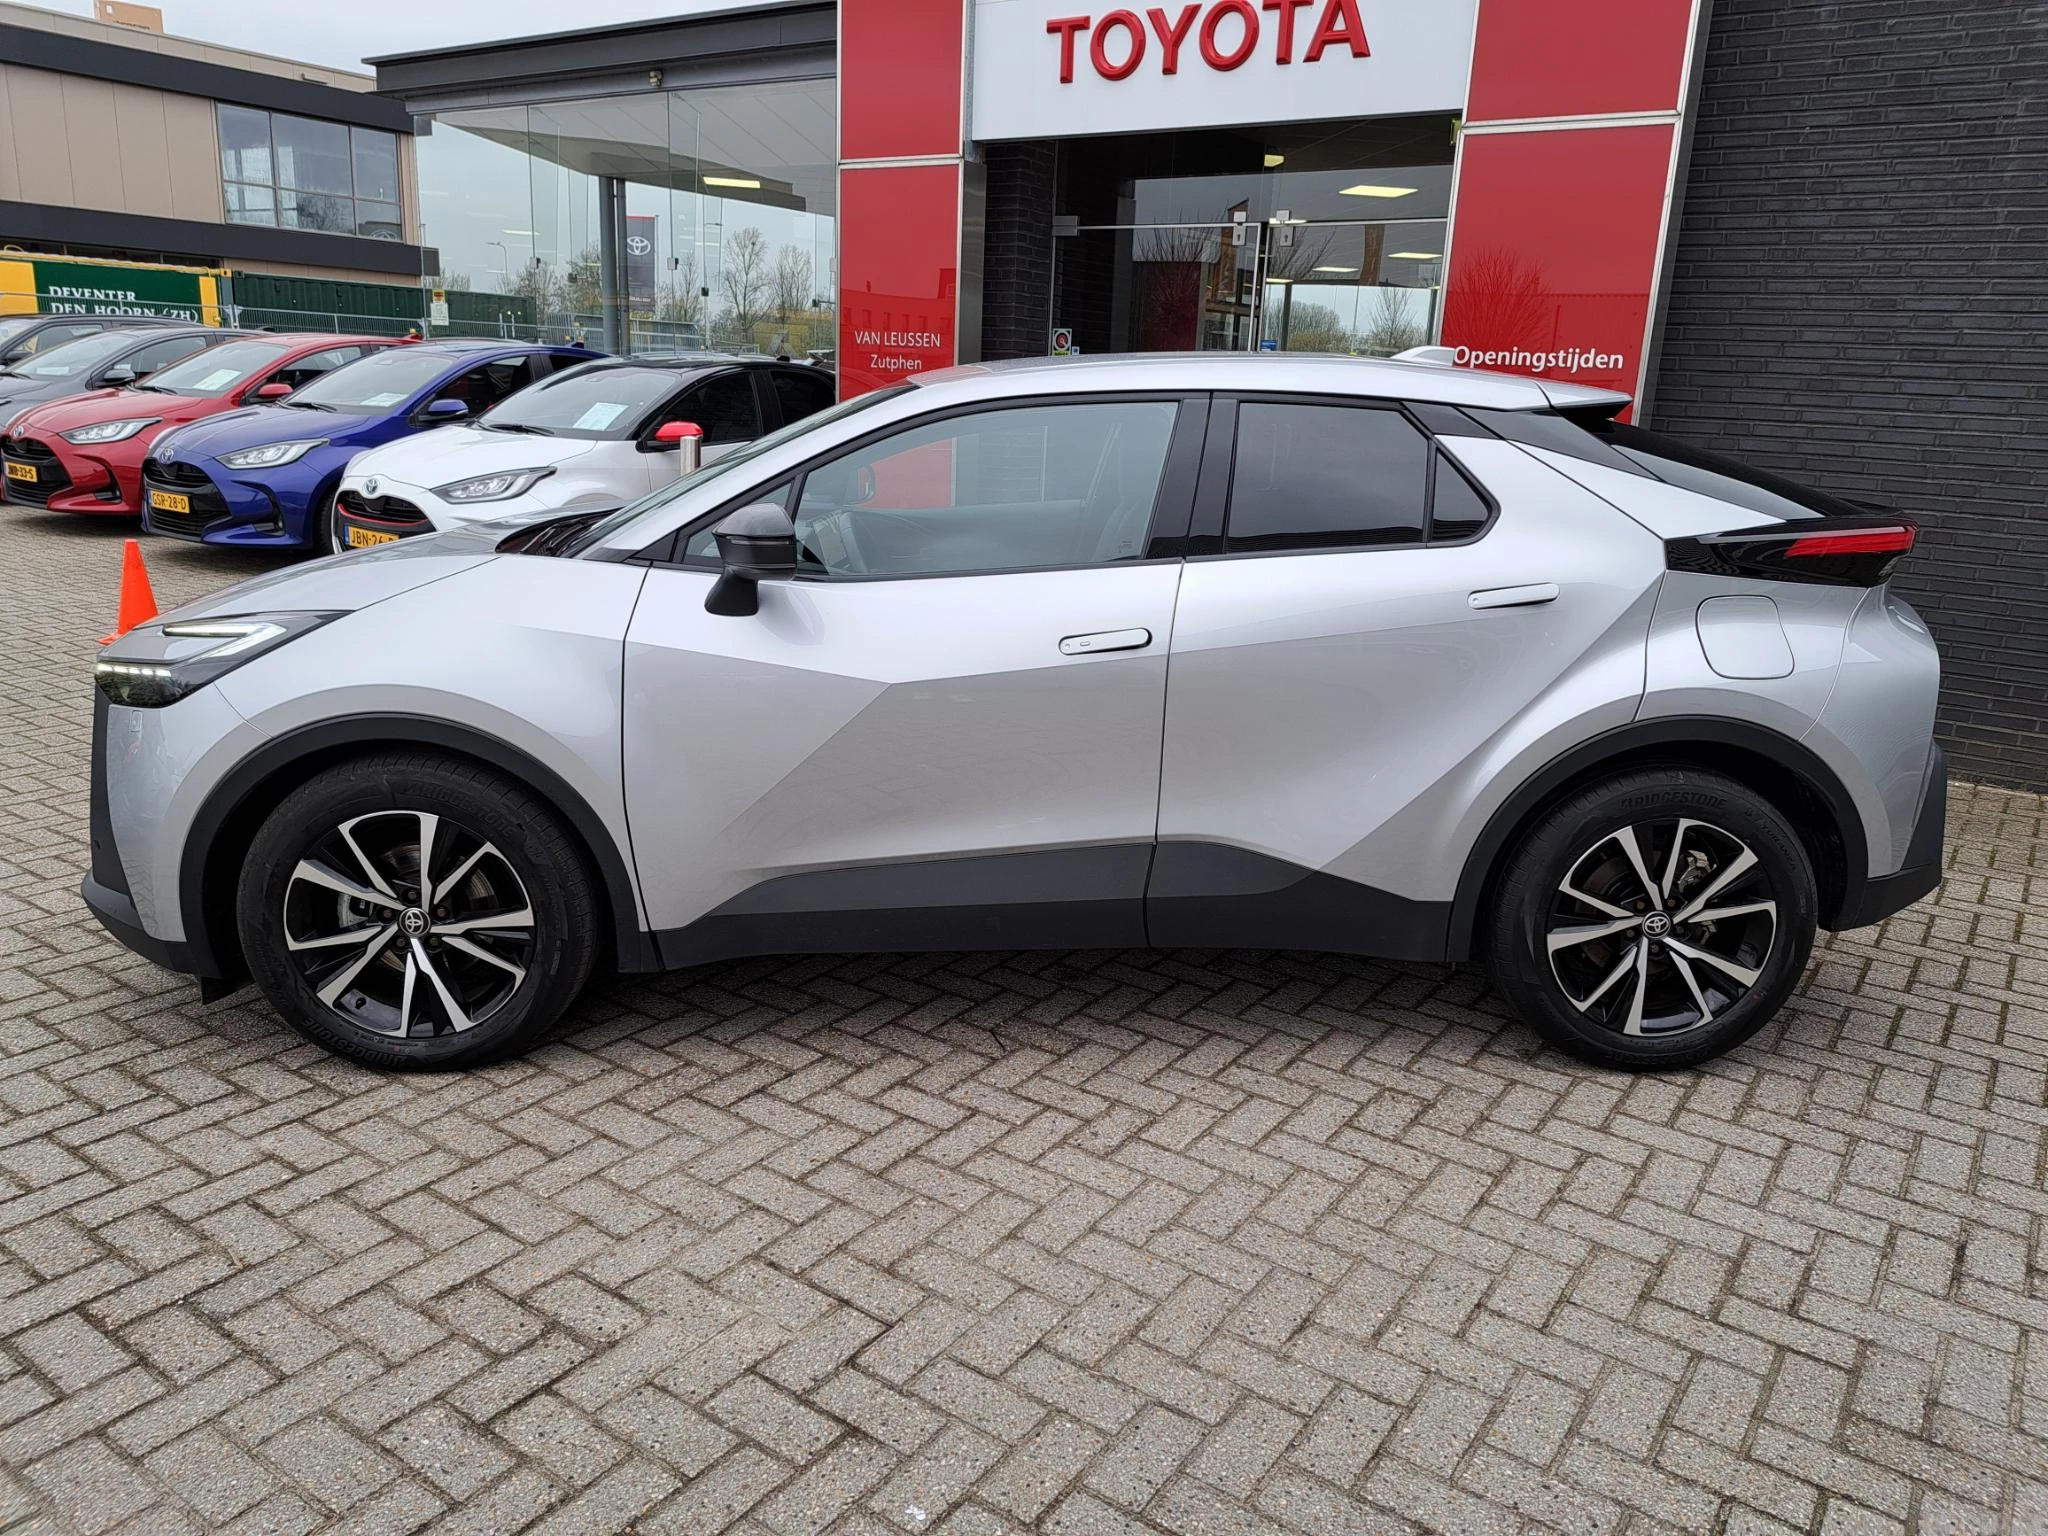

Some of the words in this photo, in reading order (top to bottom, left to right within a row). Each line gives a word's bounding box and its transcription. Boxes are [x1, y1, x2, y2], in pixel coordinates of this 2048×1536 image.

[1046, 0, 1371, 84] TOYOTA
[48, 285, 136, 302] DEVENTER
[50, 302, 86, 315] DEN
[94, 304, 156, 317] HOORN
[855, 331, 881, 346] VAN
[883, 331, 942, 348] LEUSSEN
[870, 354, 923, 372] Zutphen
[1453, 345, 1625, 373] Openingstijden
[1620, 791, 1728, 810] BRIDGESTONE
